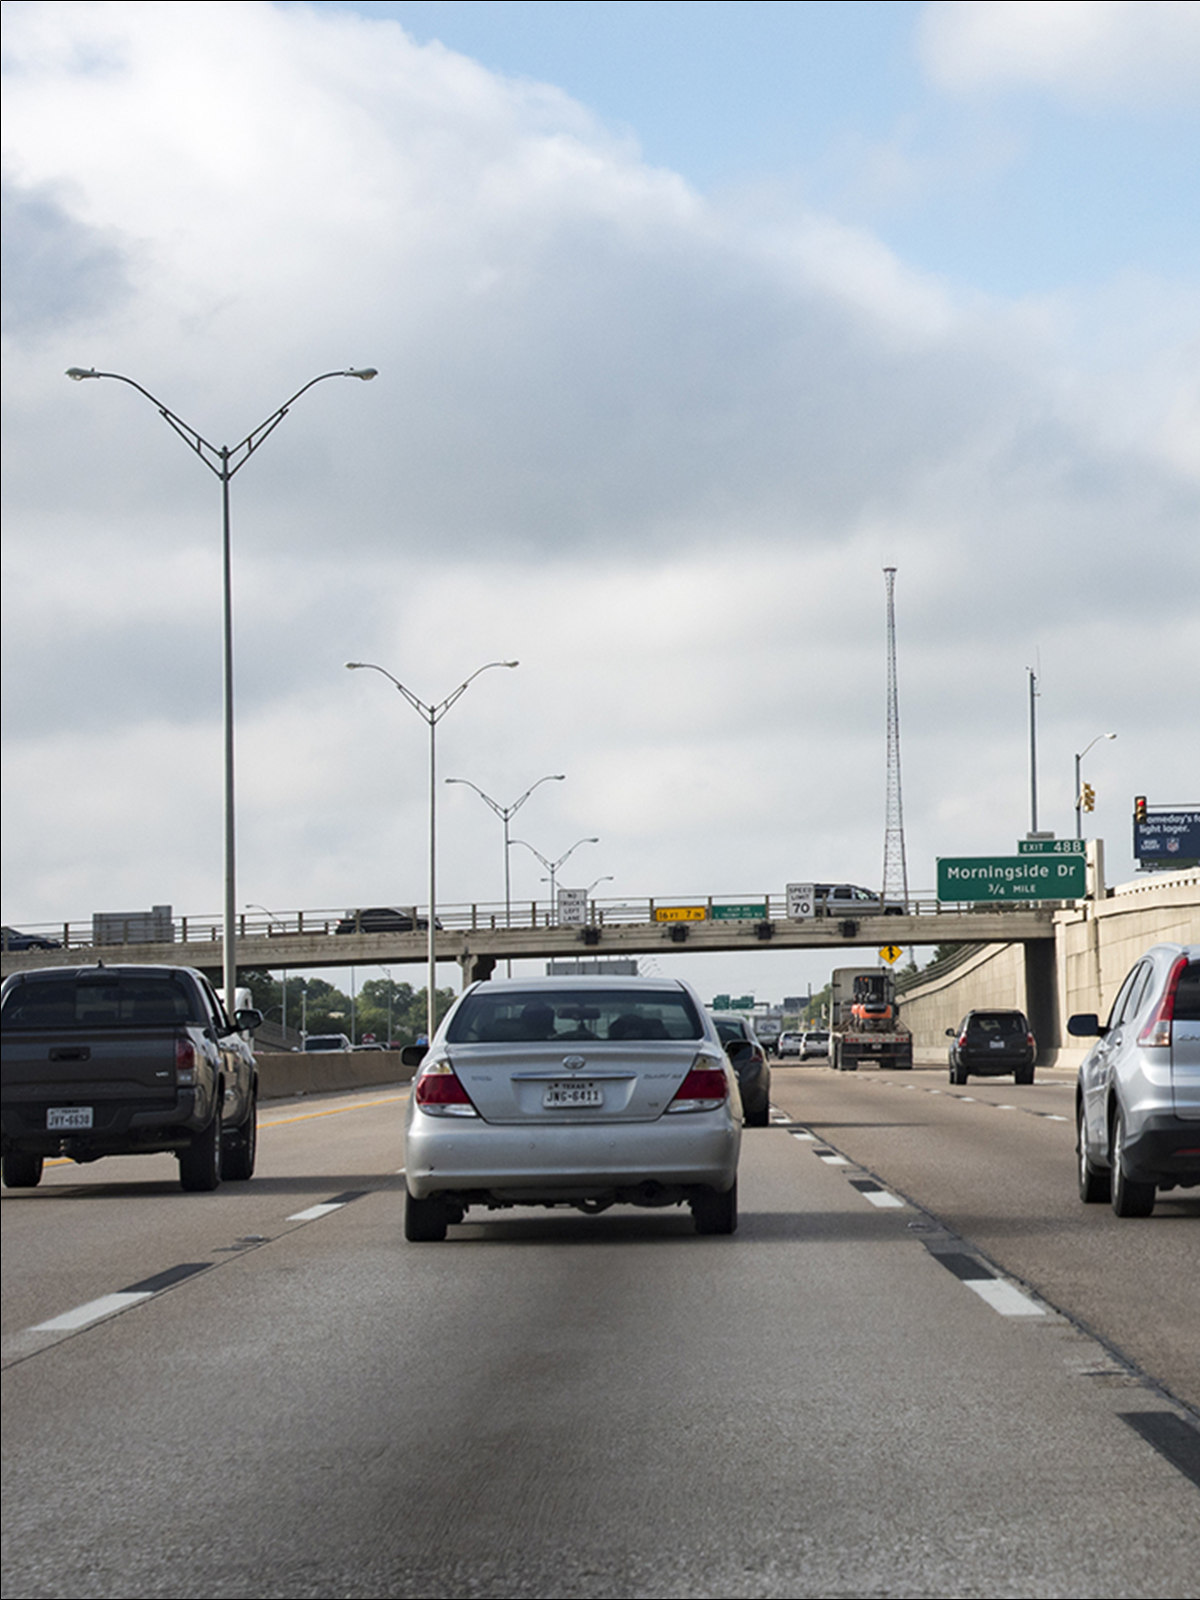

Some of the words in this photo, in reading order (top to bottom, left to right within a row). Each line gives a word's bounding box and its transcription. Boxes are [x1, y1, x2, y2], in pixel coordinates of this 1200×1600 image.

[1146, 814, 1193, 825] ameday's
[1139, 824, 1162, 834] light
[1022, 843, 1044, 852] EXIT
[1053, 841, 1082, 853] 48B
[947, 864, 1049, 881] Morningside
[1057, 864, 1076, 877] Dr
[788, 886, 813, 894] SPEED
[988, 883, 1005, 895] 3/4
[1013, 884, 1037, 893] MILE
[792, 902, 810, 914] 70
[658, 911, 669, 919] 16
